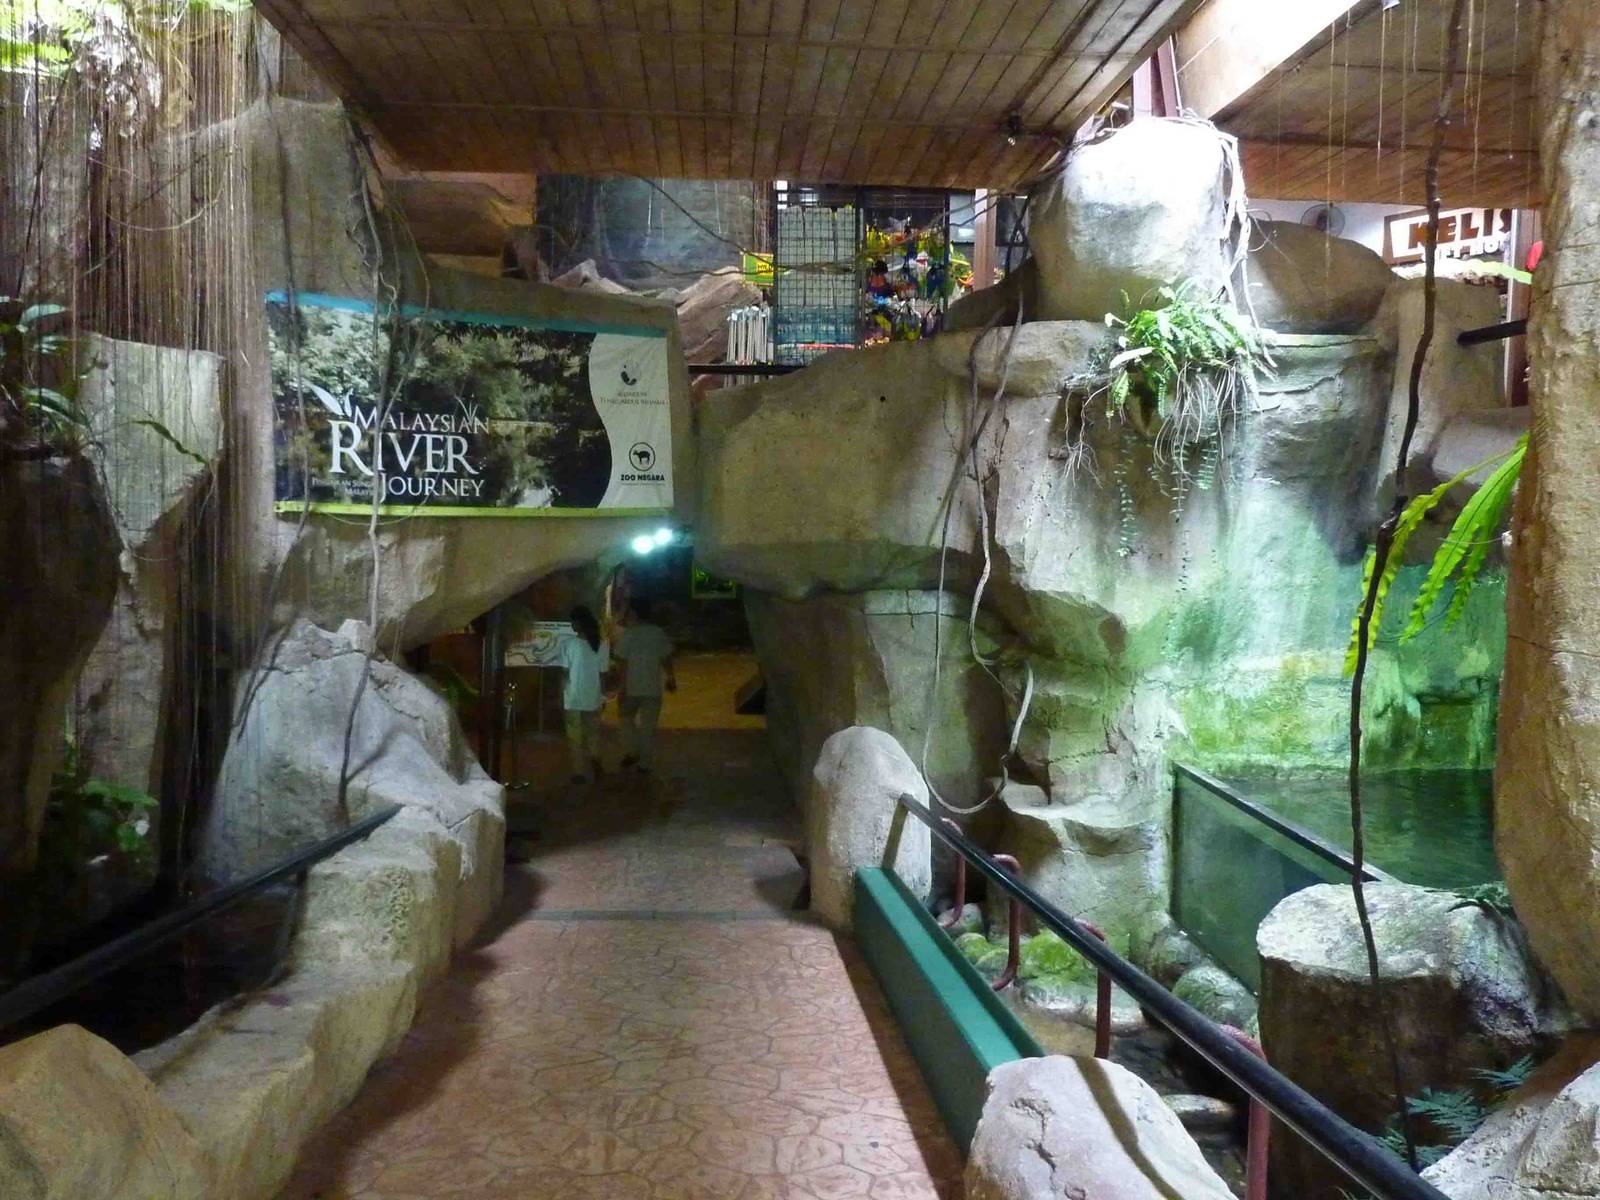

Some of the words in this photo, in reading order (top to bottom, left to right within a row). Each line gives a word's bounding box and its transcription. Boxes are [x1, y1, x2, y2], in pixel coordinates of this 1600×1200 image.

[353, 405, 490, 435] MALAYSIAN
[326, 418, 480, 476] RIVER
[379, 472, 485, 503] JOURNEY
